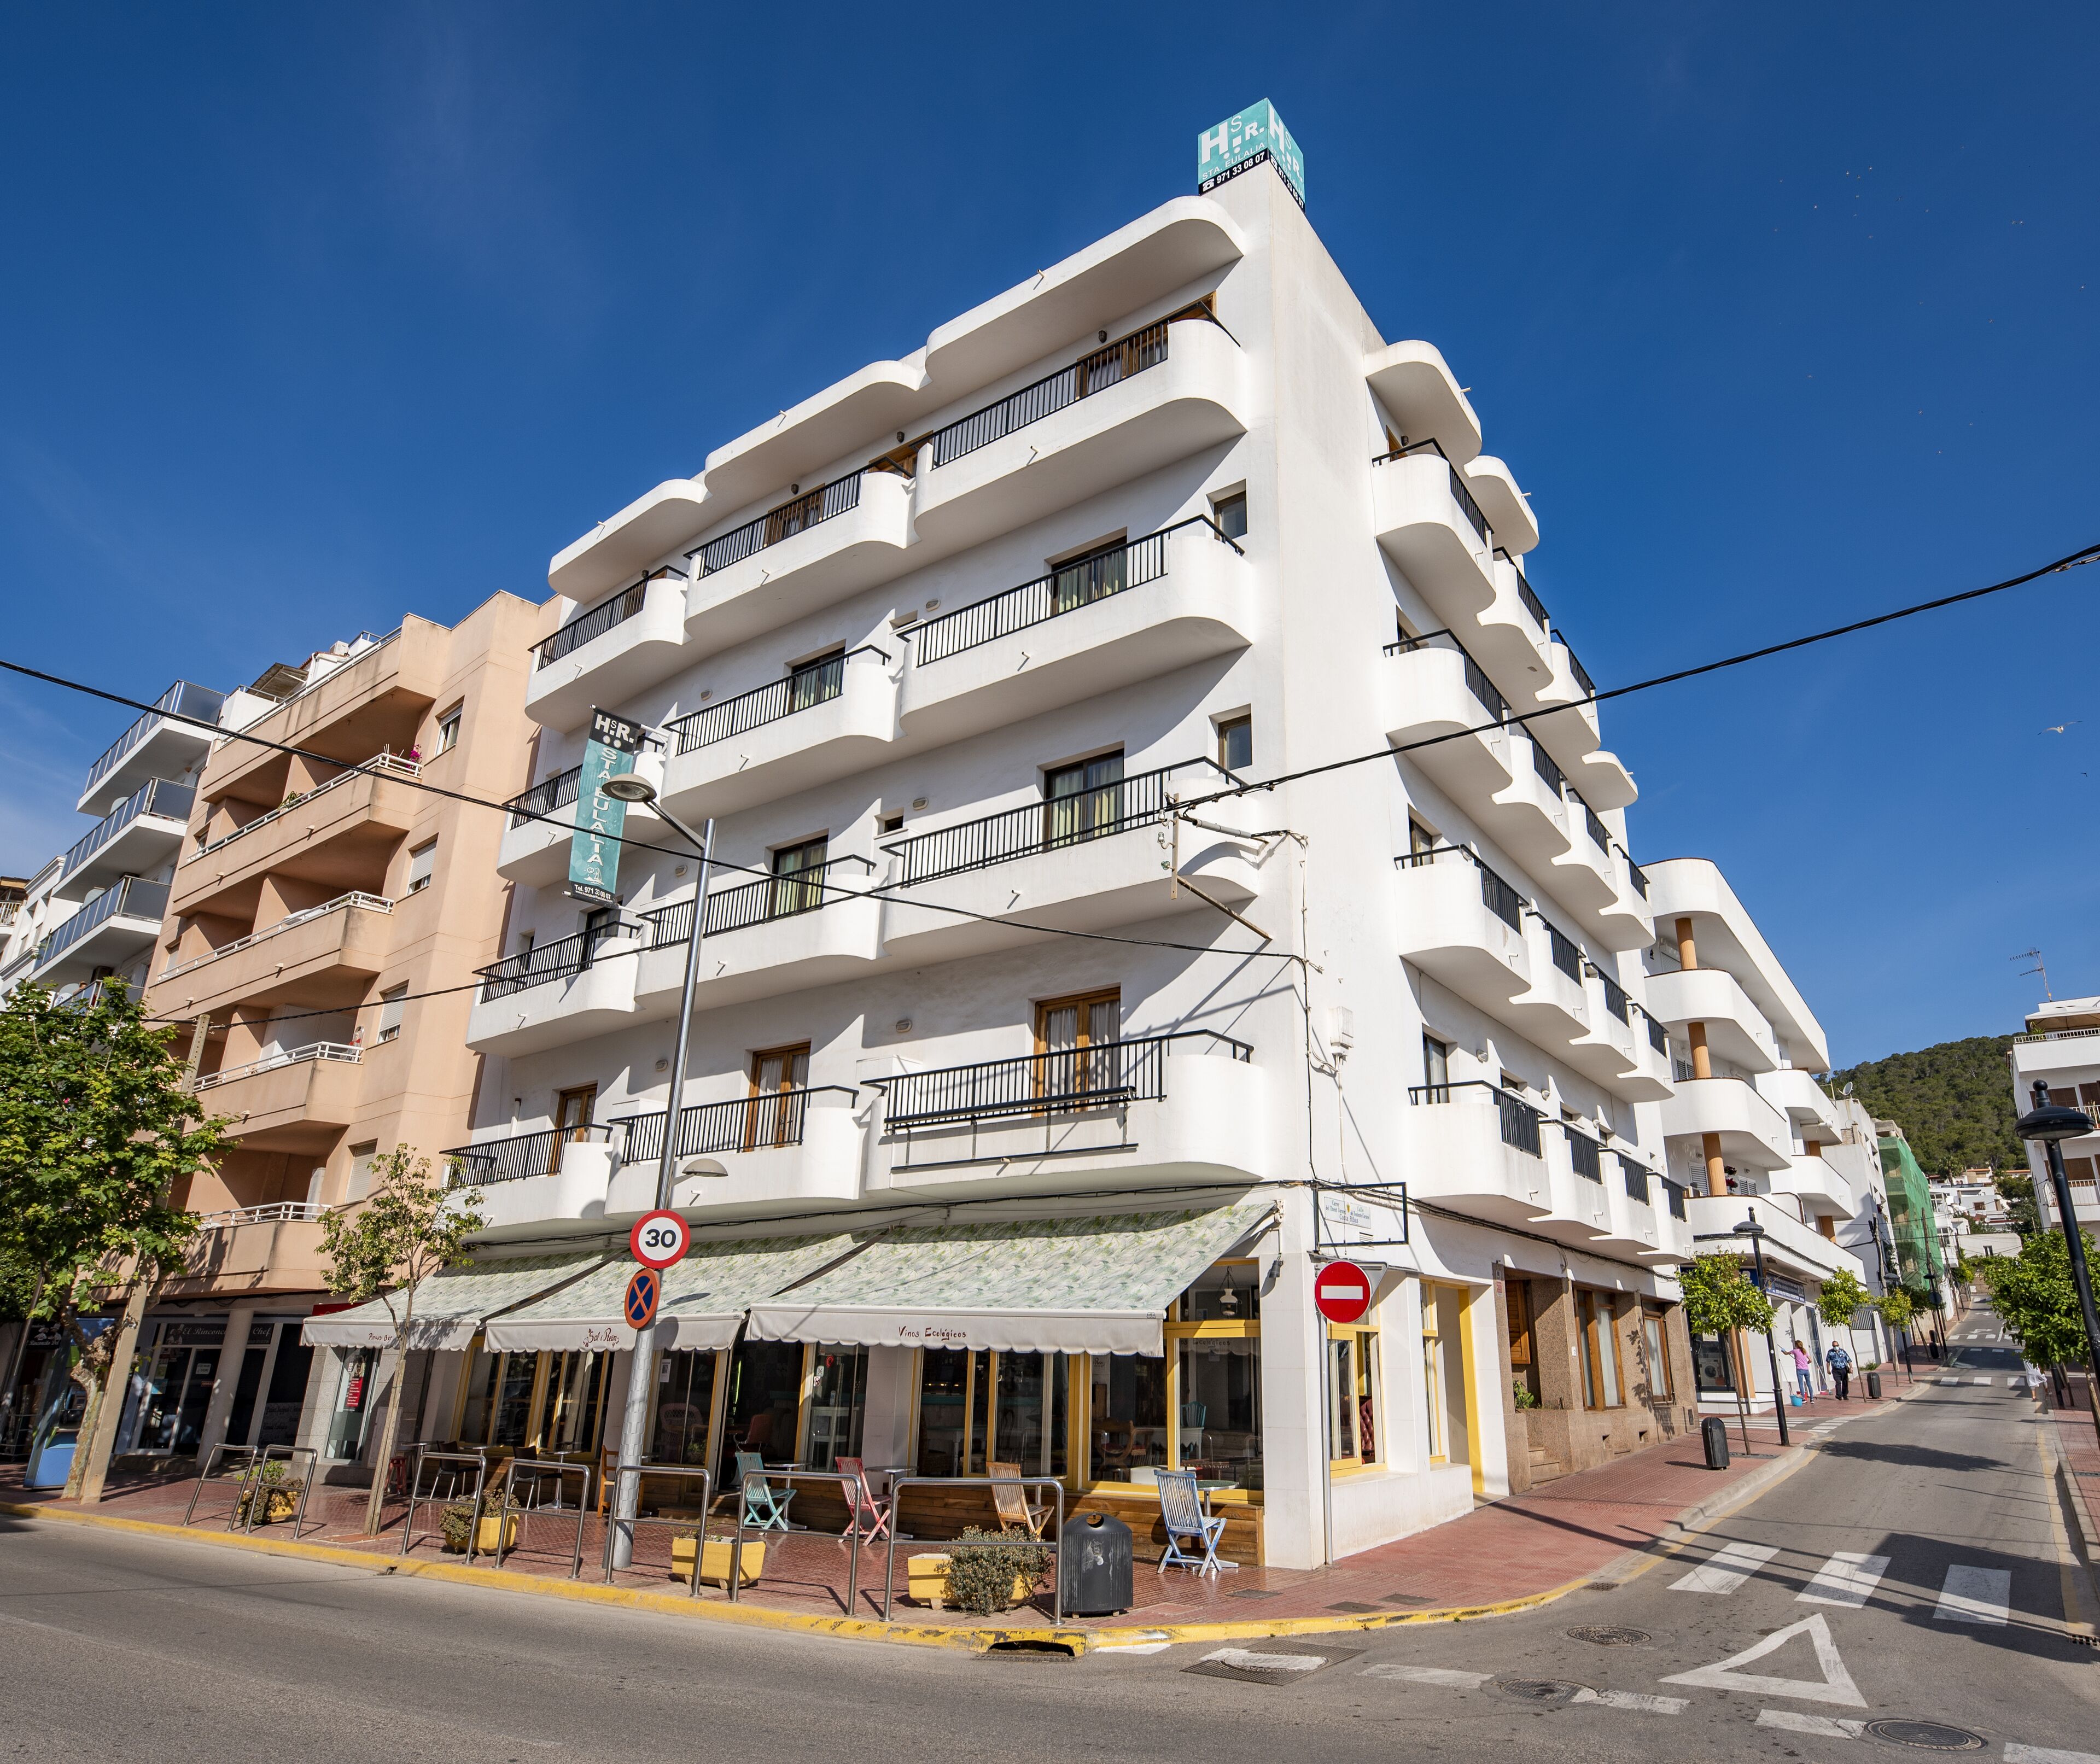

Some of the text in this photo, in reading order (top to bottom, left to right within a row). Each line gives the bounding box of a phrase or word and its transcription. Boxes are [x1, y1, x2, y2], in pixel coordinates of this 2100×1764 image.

[1202, 142, 1265, 180] STA. EULALIA
[1217, 152, 1265, 184] 971 33 08 07
[1278, 169, 1286, 184] 971
[1287, 179, 1292, 191] 33
[1299, 198, 1304, 209] 07
[587, 786, 610, 867] EULALIA
[645, 1229, 676, 1248] 30
[253, 1327, 272, 1337] Chef
[899, 1325, 966, 1341] Vinos Ecológicos
